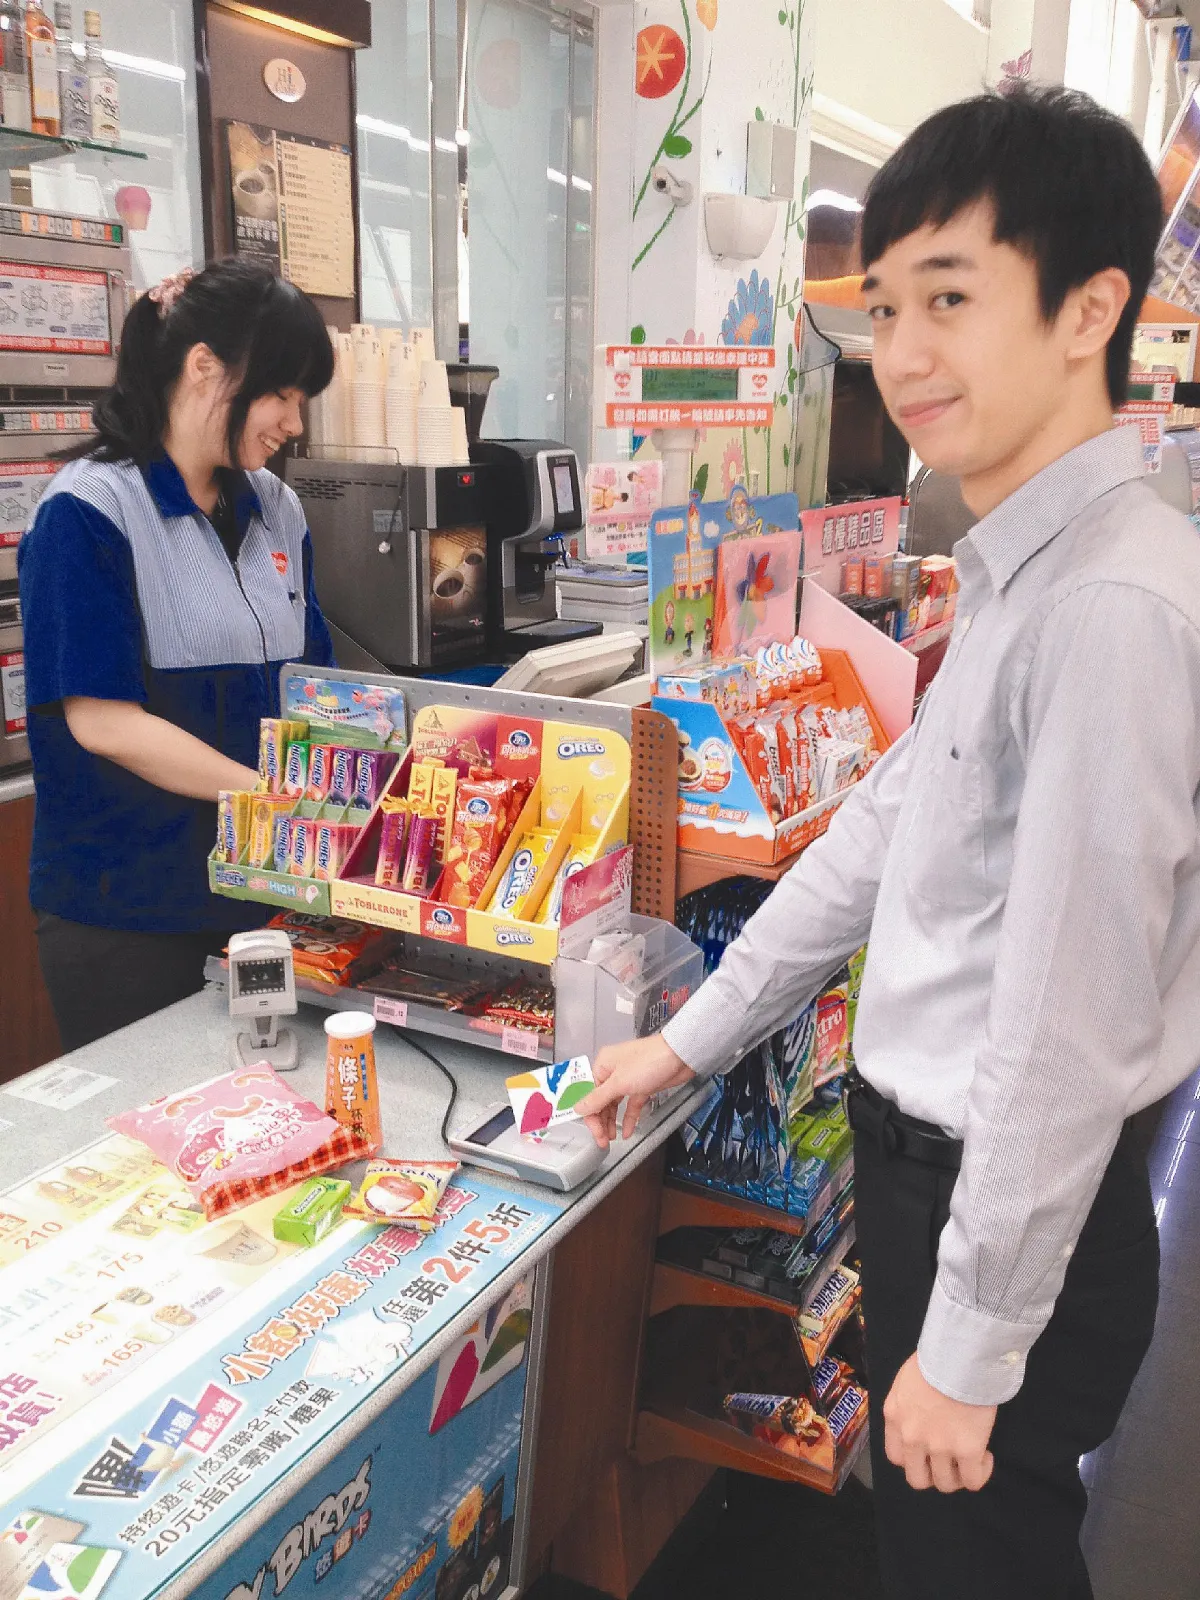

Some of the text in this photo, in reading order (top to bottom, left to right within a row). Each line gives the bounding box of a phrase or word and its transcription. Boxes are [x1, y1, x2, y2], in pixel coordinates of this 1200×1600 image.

[557, 742, 605, 759] OREO
[268, 880, 296, 897] HIGH
[501, 848, 533, 909] OREO
[353, 897, 408, 918] TOBLERONE
[496, 933, 534, 946] OREO
[817, 1007, 843, 1038] tra
[13, 1221, 64, 1251] 210
[96, 1252, 144, 1279] 175
[400, 1202, 536, 1306] 第2件5折
[222, 1271, 374, 1384] 小額好康
[342, 1186, 479, 1278] 好事雙
[810, 1270, 849, 1318] SNICKERS
[54, 1321, 95, 1346] 165
[101, 1340, 144, 1367] 165
[814, 1355, 840, 1398] CKERS
[162, 1411, 196, 1445] 小額
[826, 1385, 863, 1438] SNICKERS
[119, 1377, 315, 1546] 持悠遊卡/悠遊聯名卡付款
[144, 1386, 341, 1558] 20元指定零嘴/糖果
[266, 1453, 373, 1597] BIRDS
